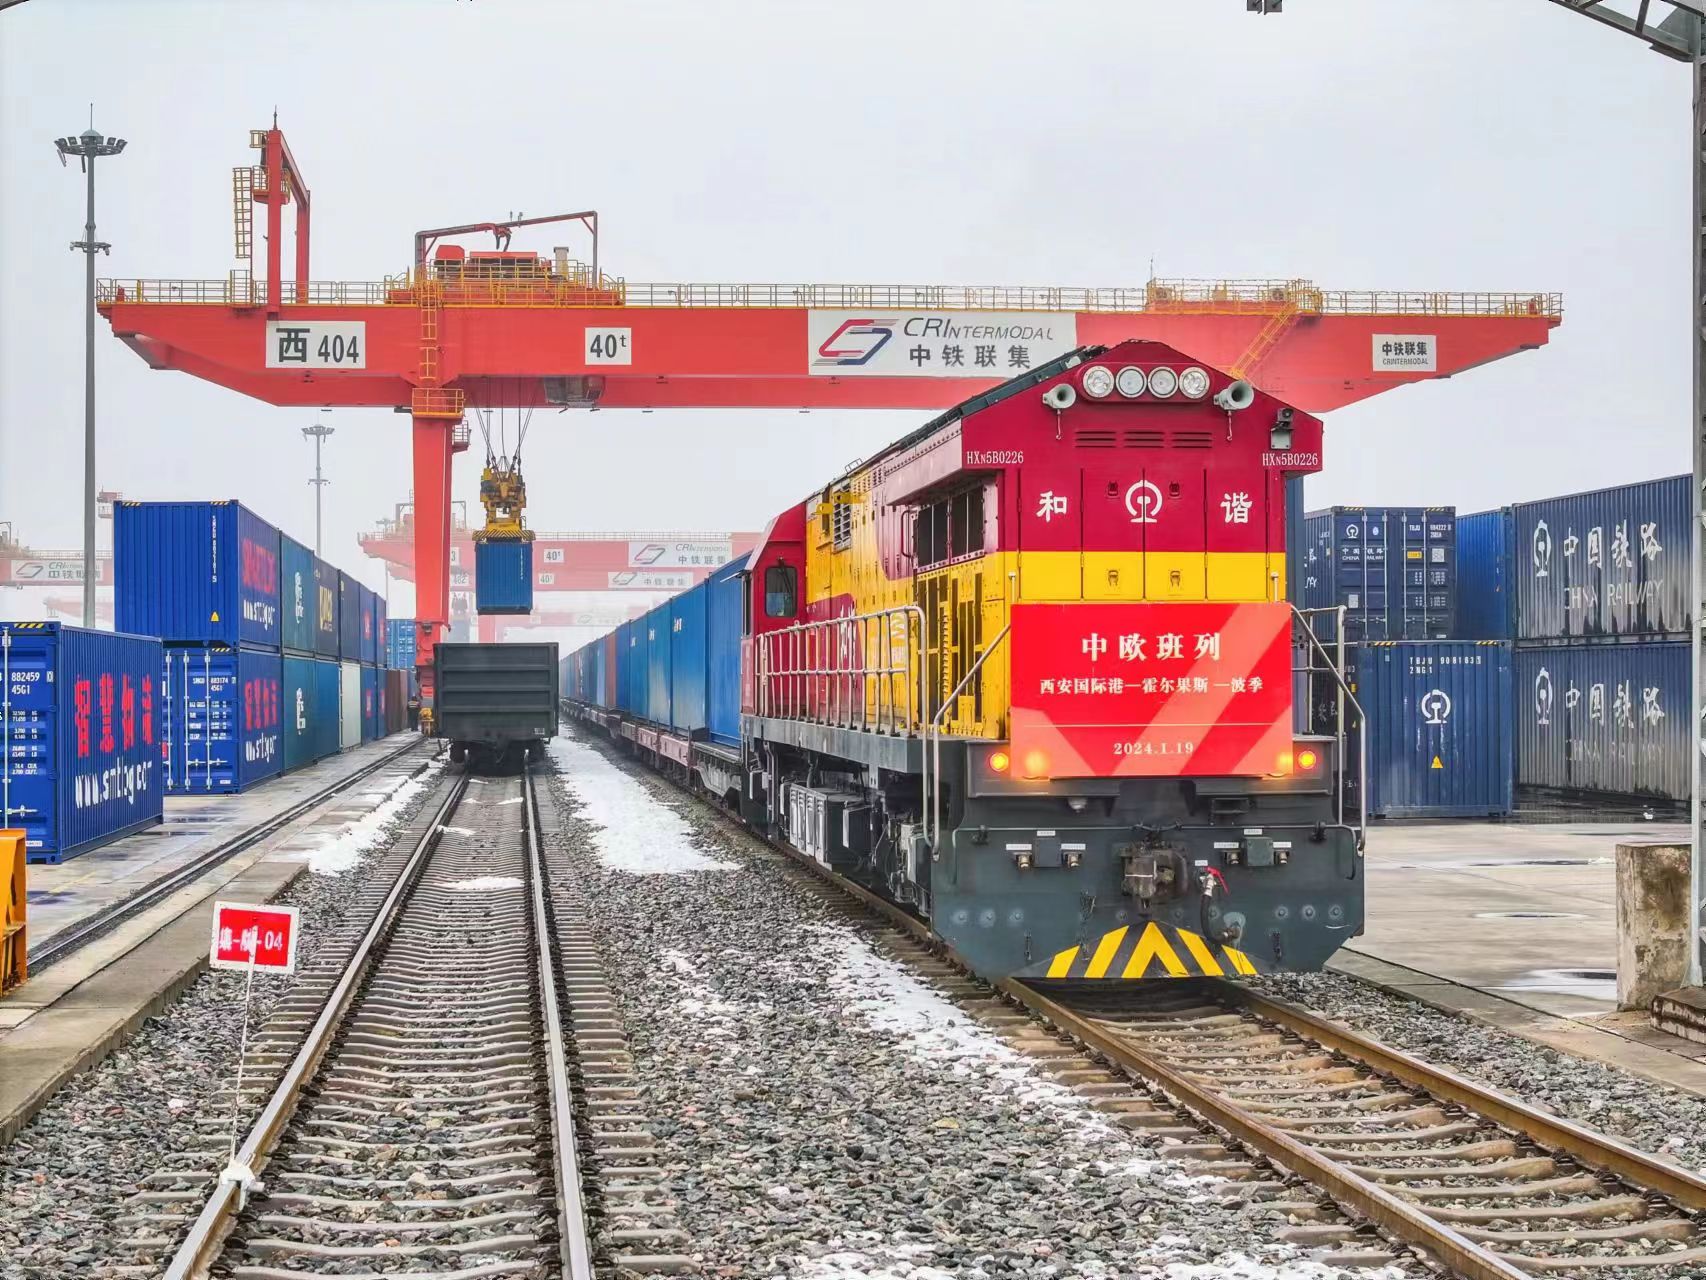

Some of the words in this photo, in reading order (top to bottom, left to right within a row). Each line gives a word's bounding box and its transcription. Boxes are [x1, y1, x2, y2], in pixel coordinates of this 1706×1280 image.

[276, 327, 311, 363] 西
[317, 335, 359, 364] 404
[590, 334, 627, 359] 40t
[909, 344, 1031, 369] 中铁联集
[1382, 341, 1428, 356] 中铁联集
[1035, 490, 1068, 523] 和
[1220, 491, 1253, 524] 谐
[1563, 519, 1663, 578] 中国铁路
[1081, 632, 1222, 662] 中欧班列
[11, 672, 40, 682] 882459
[11, 685, 31, 695] 45G1
[1566, 679, 1665, 730] 中国铁路
[1113, 742, 1195, 755] 2024.1.19
